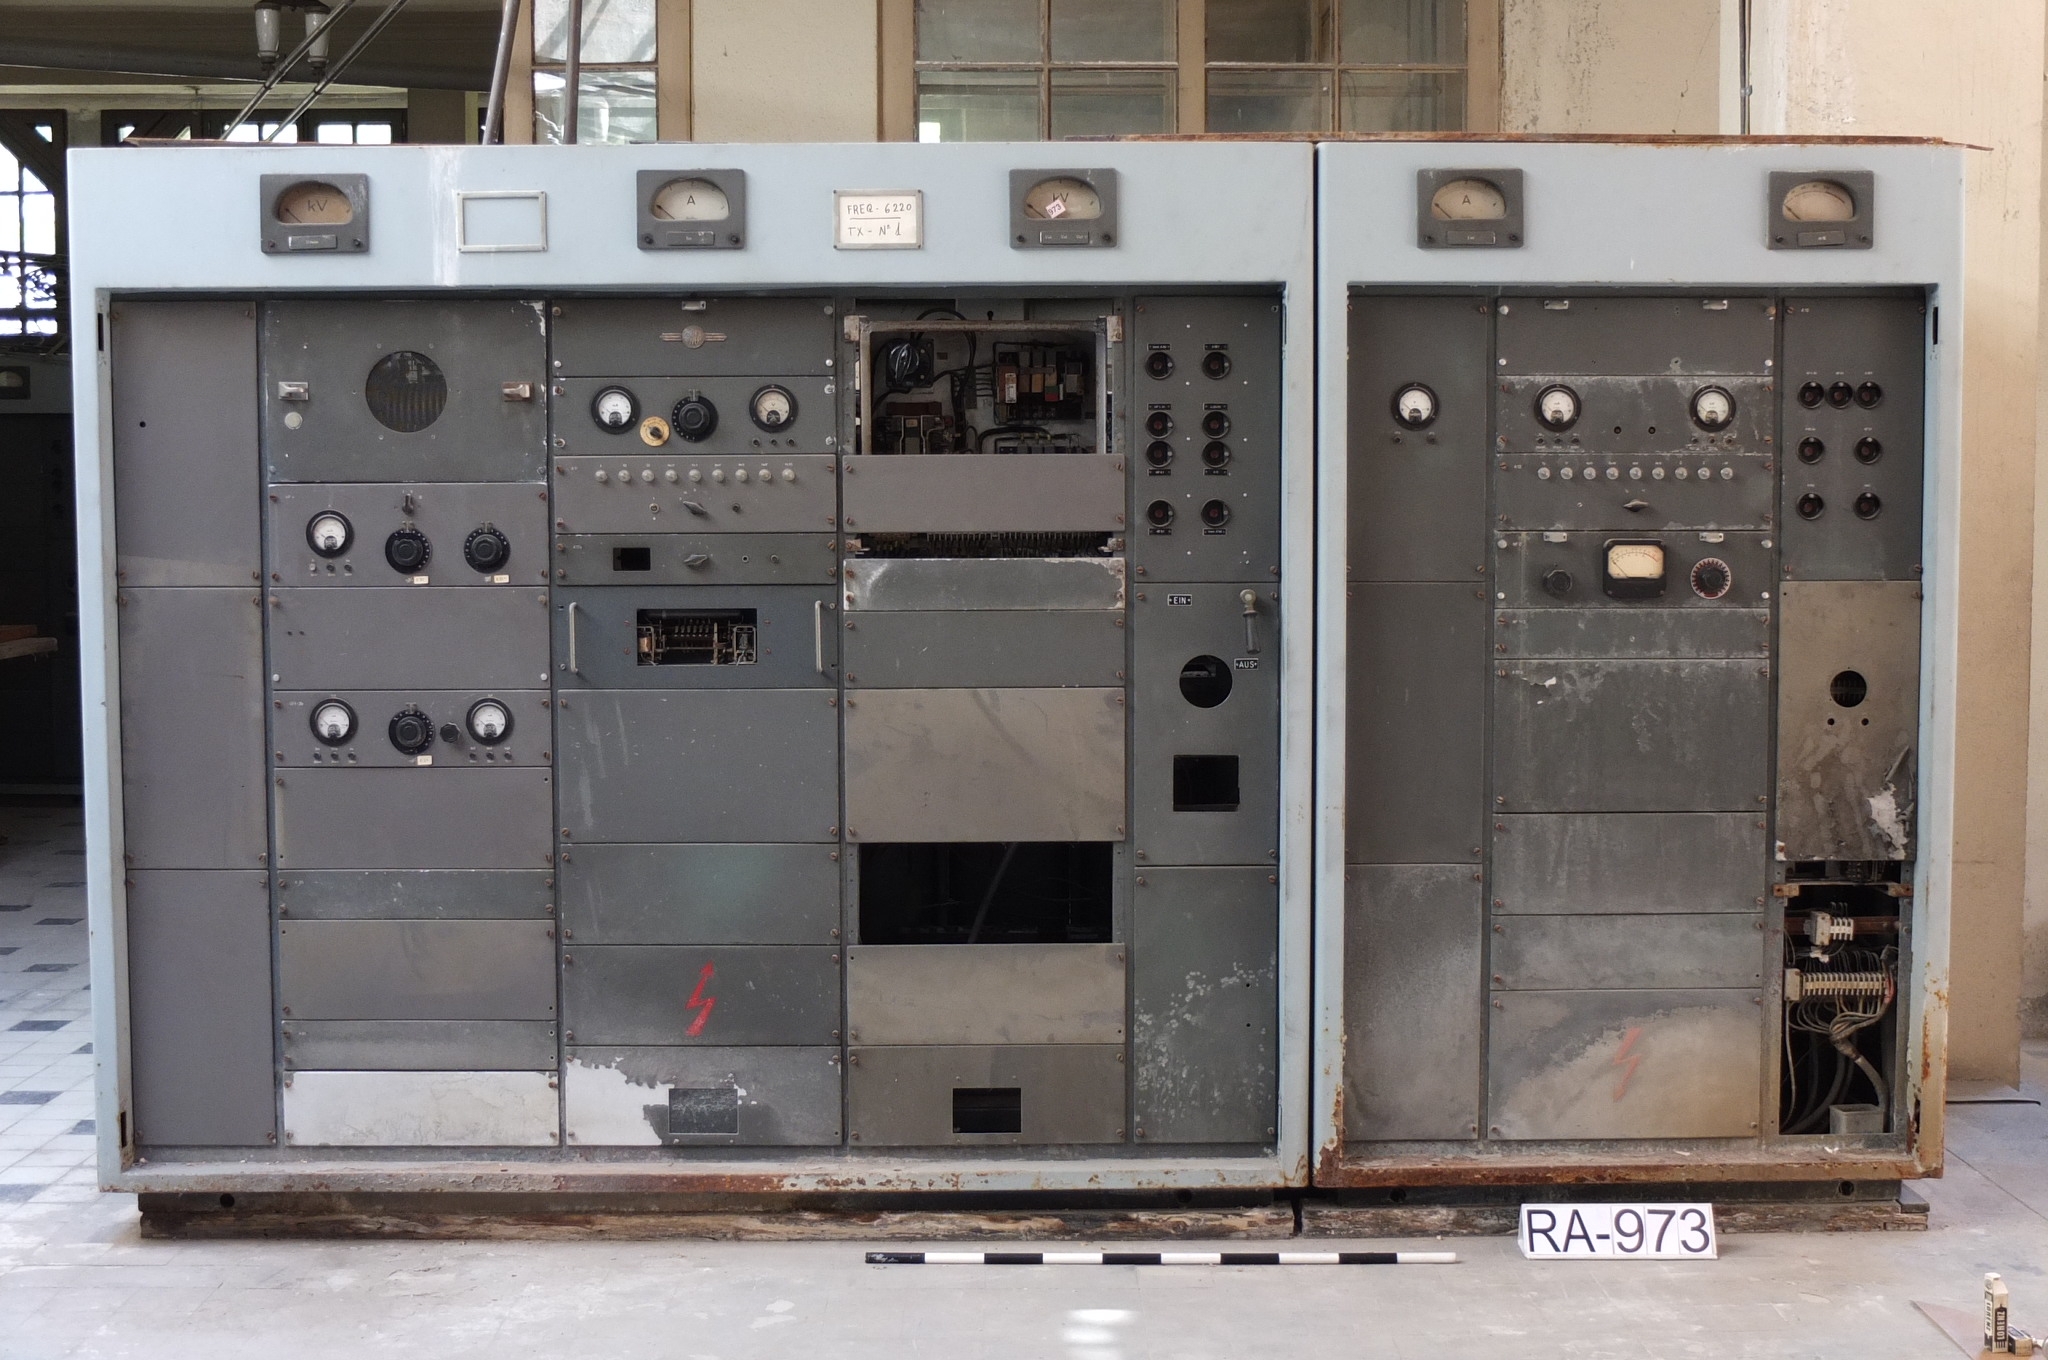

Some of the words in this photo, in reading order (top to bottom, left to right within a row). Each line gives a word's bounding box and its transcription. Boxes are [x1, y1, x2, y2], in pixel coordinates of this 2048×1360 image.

[686, 194, 696, 205] A
[1461, 194, 1471, 205] A
[307, 199, 328, 212] kV
[847, 203, 873, 215] FREQ
[884, 203, 912, 213] 6220
[1047, 203, 1062, 216] 973
[848, 226, 864, 236] TX
[1173, 596, 1187, 605] EIN
[1238, 660, 1255, 669] AUS
[1526, 1208, 1710, 1253] RA-973
[1996, 1310, 2006, 1340] LORENZ
